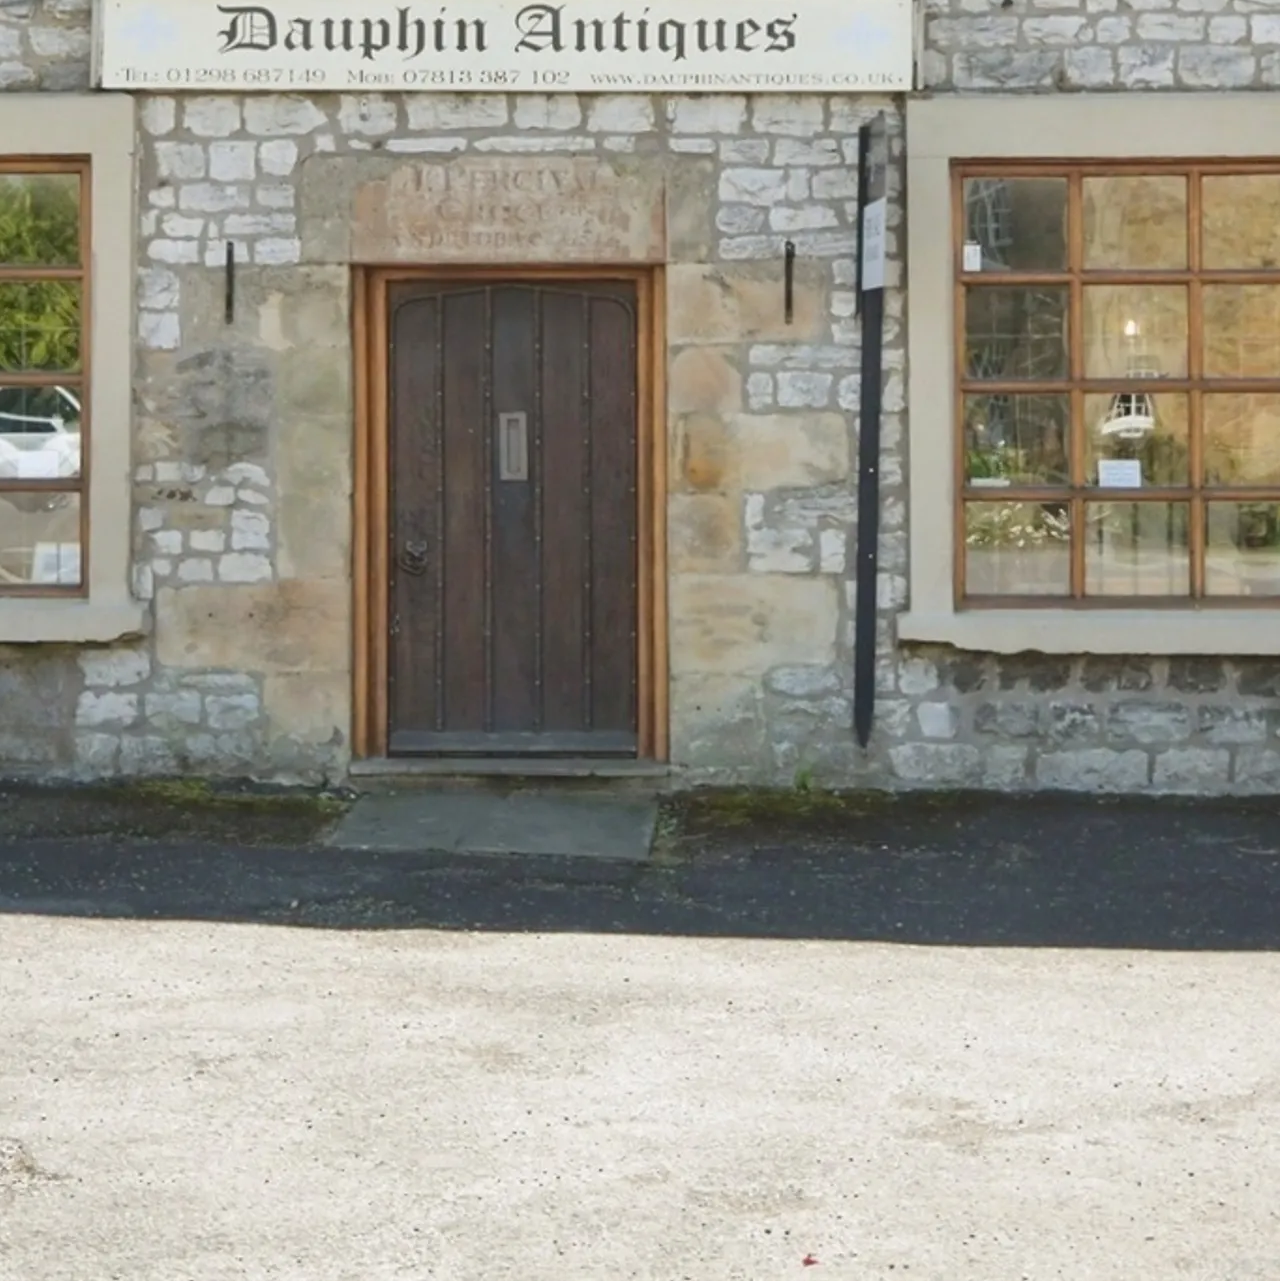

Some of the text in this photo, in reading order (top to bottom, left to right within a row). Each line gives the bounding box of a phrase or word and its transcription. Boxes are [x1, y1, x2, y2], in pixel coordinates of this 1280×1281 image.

[216, 4, 797, 61] Dauphin Antiques
[166, 68, 236, 83] 01298
[242, 68, 326, 84] 687149
[402, 69, 472, 84] 07813
[532, 69, 570, 84] 102
